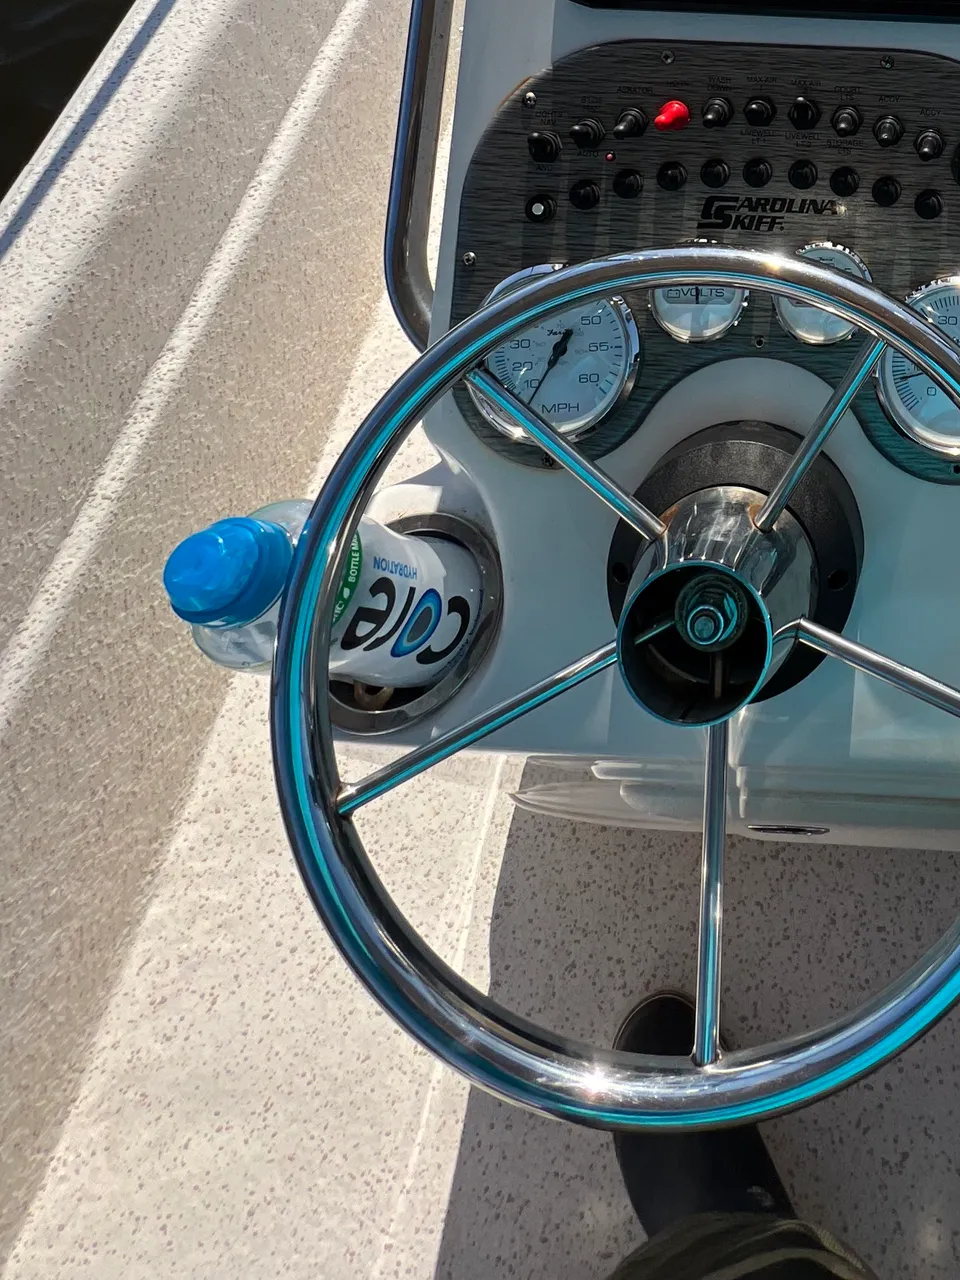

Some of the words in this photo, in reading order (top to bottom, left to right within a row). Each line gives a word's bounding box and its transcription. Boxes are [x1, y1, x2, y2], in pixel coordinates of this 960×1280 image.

[878, 95, 901, 103] ACCY
[920, 108, 942, 116] ACCY
[700, 195, 838, 220] CAROLINA
[580, 315, 602, 326] 50
[937, 315, 958, 326] 30
[509, 339, 531, 349] 30
[588, 341, 610, 352] 55
[512, 362, 533, 372] 20
[523, 378, 541, 390] 10
[578, 373, 600, 384] 60
[926, 386, 937, 397] 0
[541, 402, 580, 415] MPH
[347, 551, 361, 584] BOTTLE
[373, 556, 418, 581] HYDRATION
